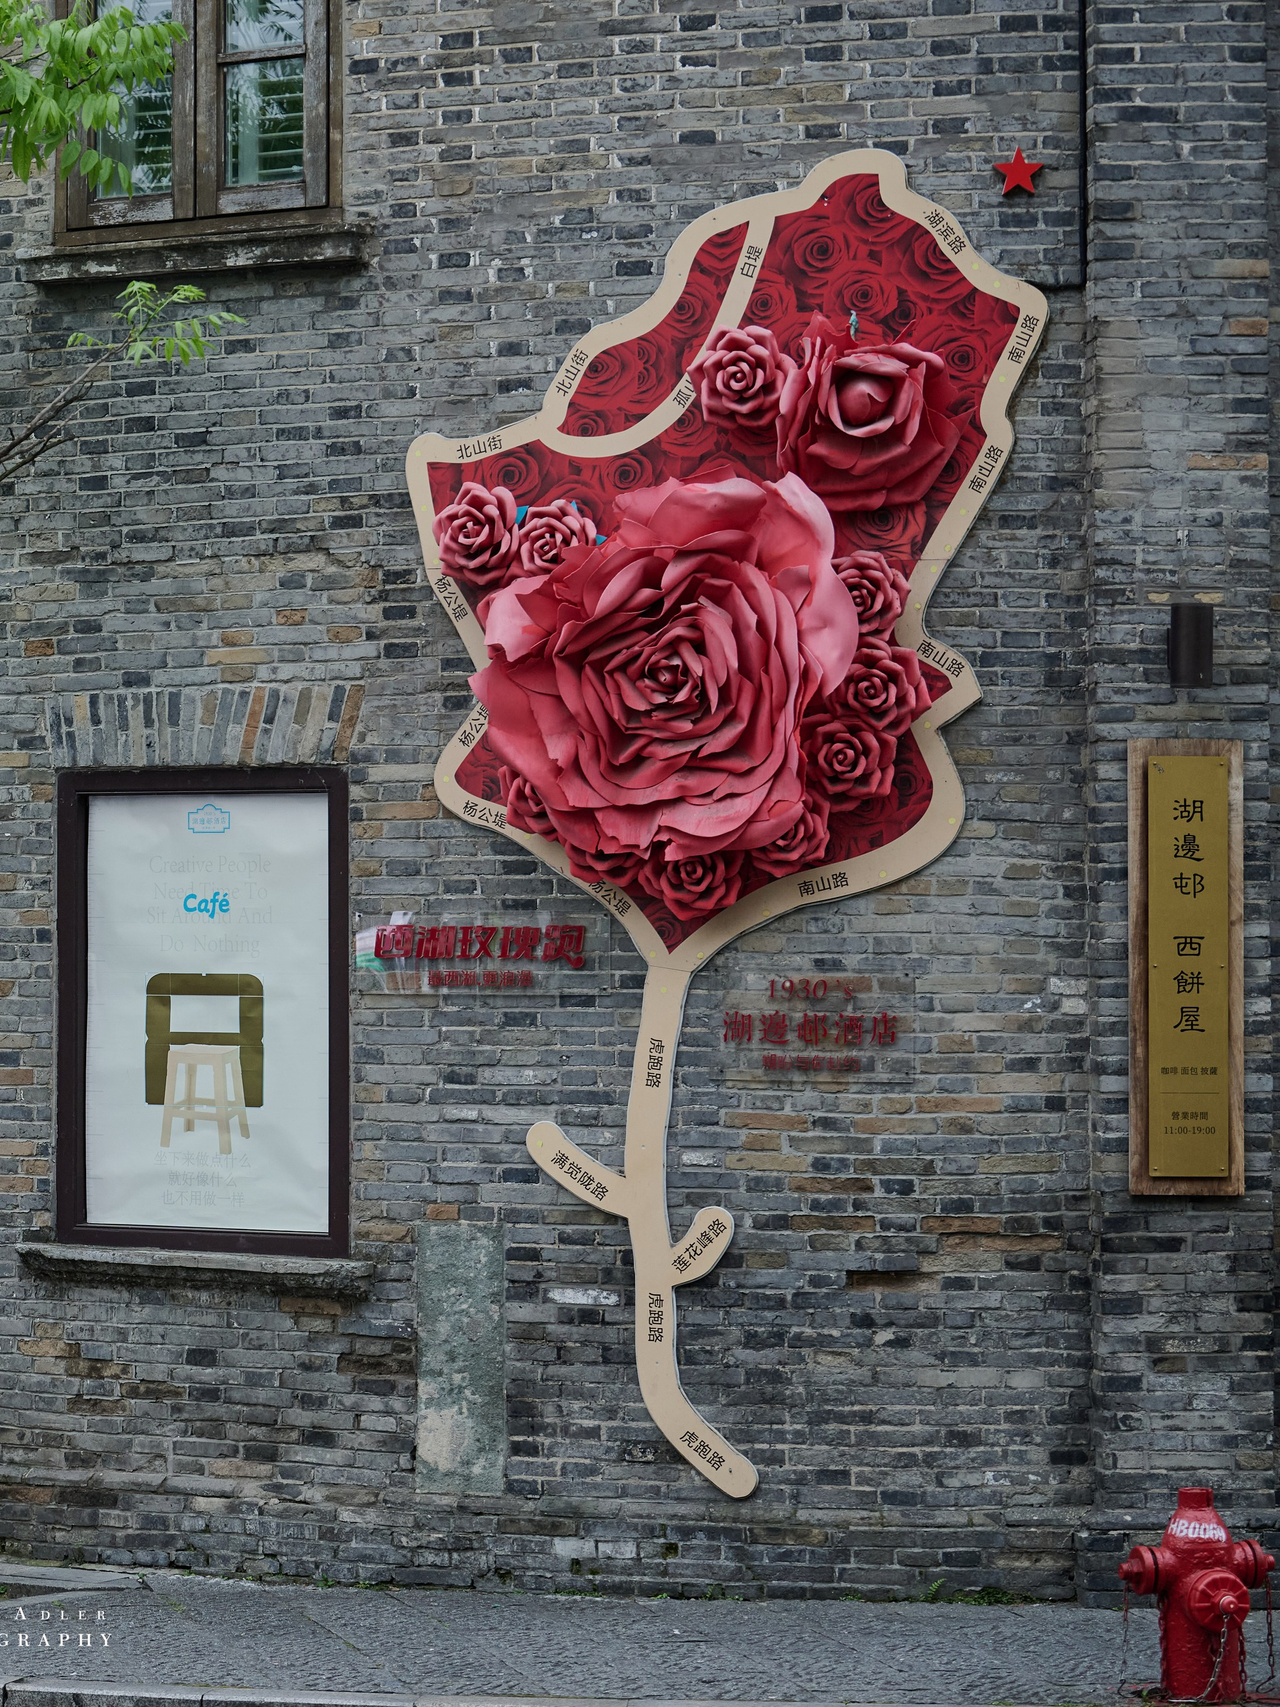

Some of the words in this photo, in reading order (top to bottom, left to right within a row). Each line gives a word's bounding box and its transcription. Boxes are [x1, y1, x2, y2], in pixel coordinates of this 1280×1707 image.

[924, 209, 967, 255] 湖滨路
[740, 245, 764, 278] 白堤
[1007, 314, 1040, 364] 南山路
[555, 348, 589, 397] 北山街
[456, 435, 503, 460] 北山街
[968, 444, 1005, 495] 南山路
[434, 575, 468, 622] 杨公堤
[917, 639, 966, 679] 南山路
[462, 800, 507, 830] 杨公堤
[149, 855, 213, 873] Creative
[218, 854, 271, 879] People
[244, 882, 268, 900] To
[797, 871, 850, 898] 南山路
[147, 906, 168, 924] Sit
[238, 905, 272, 924] And
[183, 891, 230, 919] Café
[160, 934, 184, 952] Do
[193, 933, 260, 958] Nothing
[645, 1037, 665, 1088] 虎跑路
[1160, 1066, 1178, 1075] 咖啡
[1164, 1126, 1216, 1135] 11:00-19:00
[153, 1150, 251, 1169] 坐下来做点什么
[168, 1170, 237, 1188] 就好像什么
[550, 1150, 609, 1202] 满觉陇路
[161, 1189, 245, 1208] 也不用做一样
[671, 1218, 727, 1274] 莲花峰路
[648, 1292, 664, 1343] 虎跑路
[679, 1430, 726, 1471] 虎跑路
